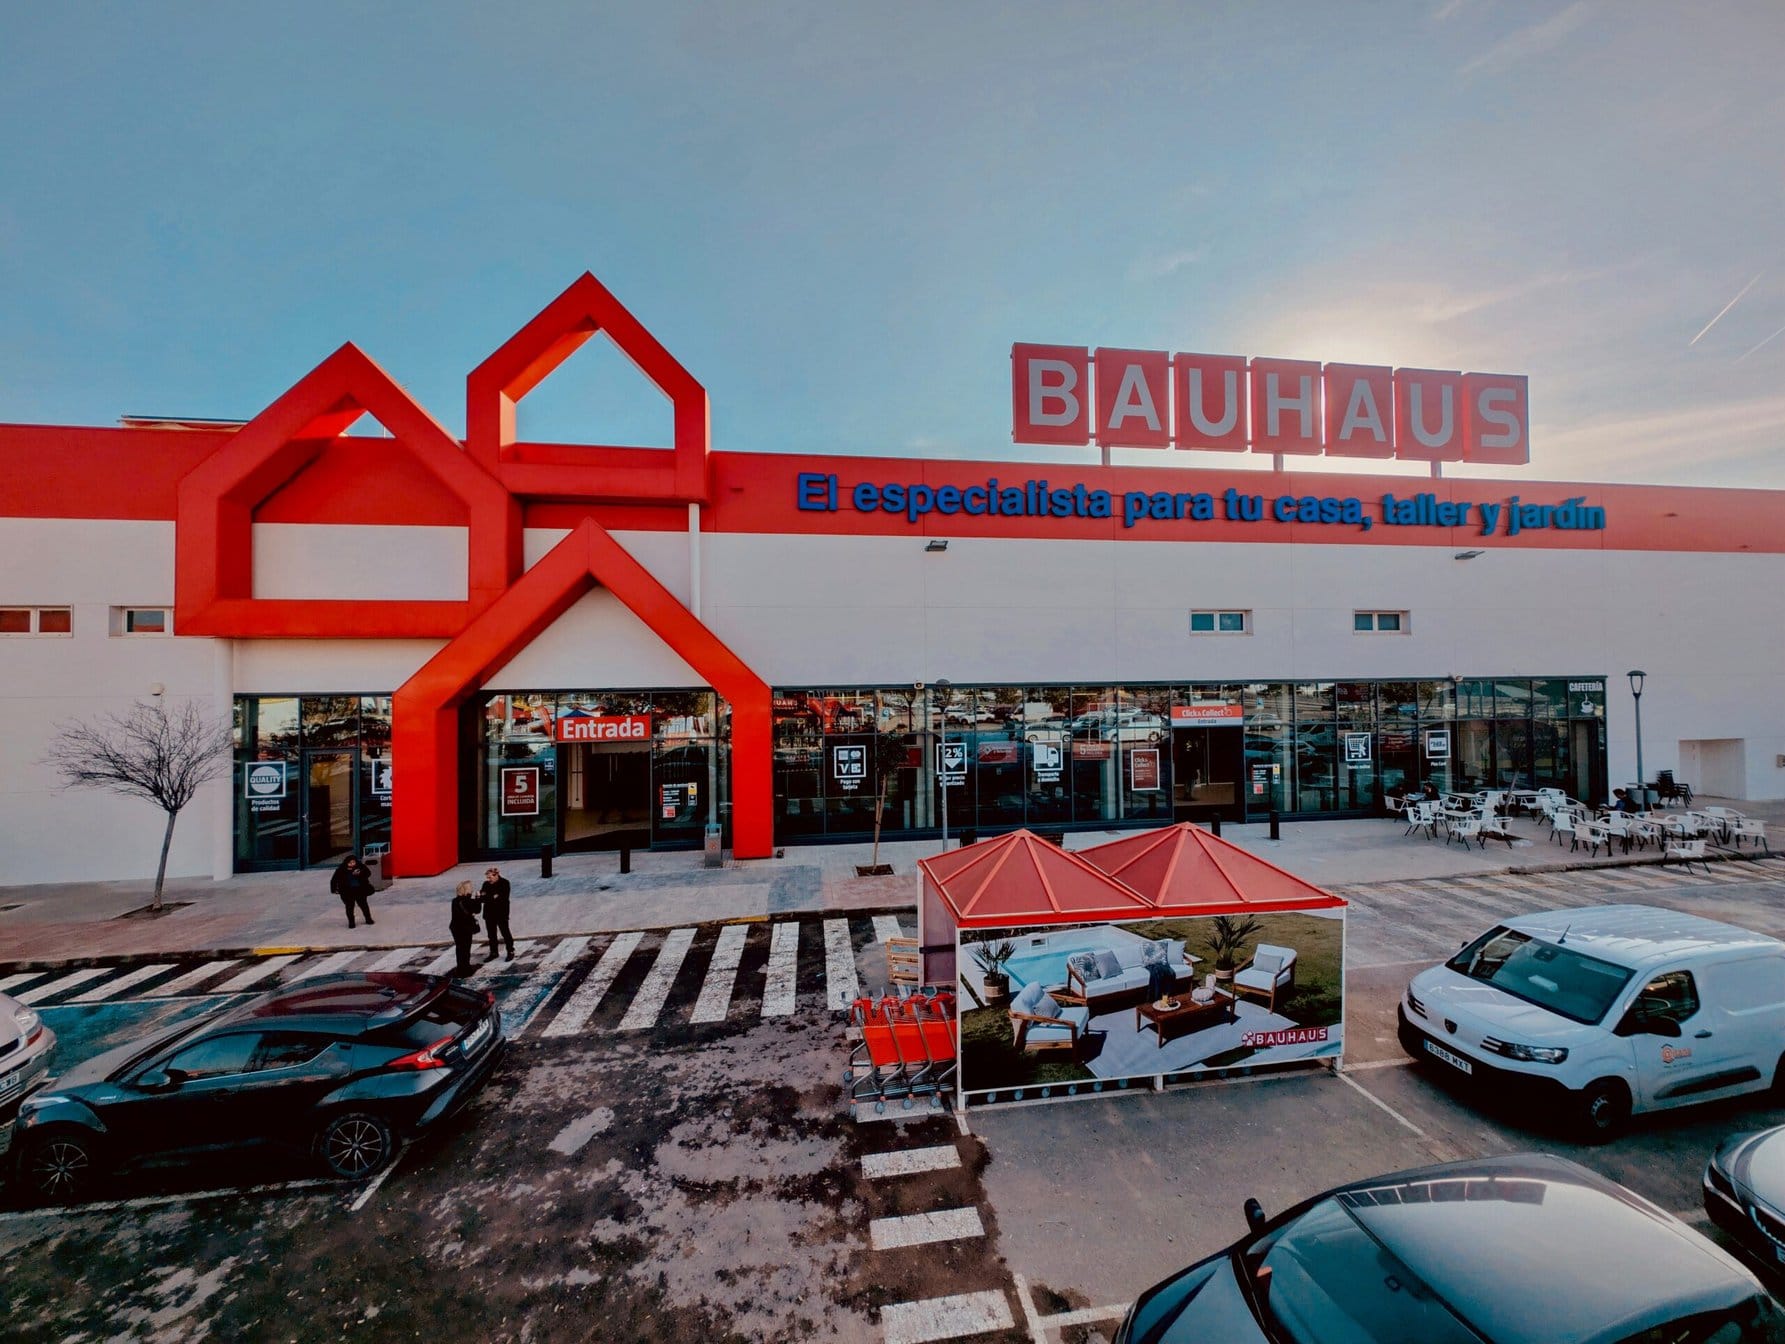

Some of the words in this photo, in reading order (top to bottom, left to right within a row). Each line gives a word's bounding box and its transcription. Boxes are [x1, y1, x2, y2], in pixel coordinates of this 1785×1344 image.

[1028, 358, 1520, 448] BAUHAUS
[798, 472, 838, 512] El
[853, 478, 1112, 524] especialista
[1125, 490, 1214, 528] para
[1224, 487, 1264, 521] tu
[1274, 493, 1373, 531] casa,
[1381, 493, 1471, 527] taller
[1479, 502, 1502, 536] y
[1506, 495, 1607, 536] jardín
[1569, 681, 1604, 692] CAFETERÍA
[1202, 709, 1224, 717] Collect
[562, 718, 645, 739] Entrada
[250, 775, 281, 784] QUALITY
[514, 775, 529, 793] 5
[1256, 1029, 1326, 1045] BAUHAUS
